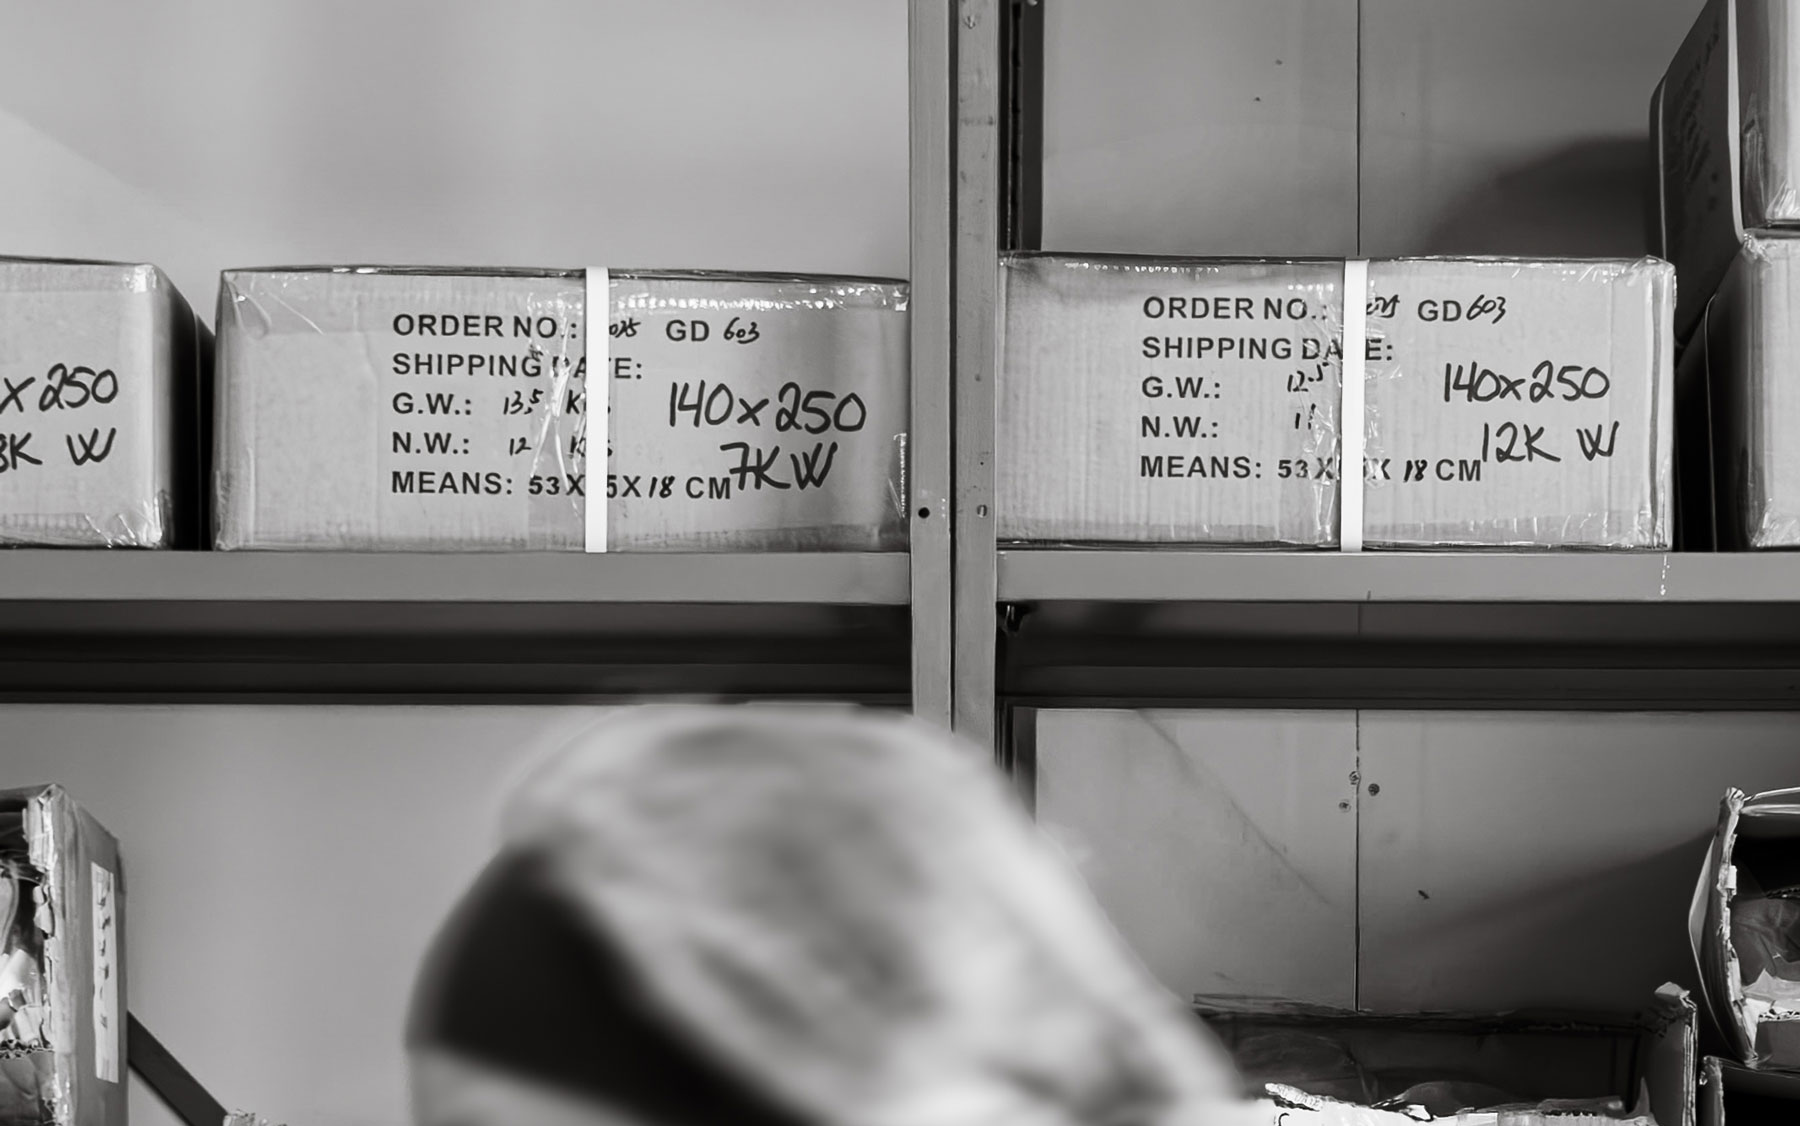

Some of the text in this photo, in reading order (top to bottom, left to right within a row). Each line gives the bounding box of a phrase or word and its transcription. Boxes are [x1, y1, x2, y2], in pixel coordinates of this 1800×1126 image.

[1143, 295, 1254, 320] ORDER
[1417, 299, 1462, 323] GD
[1466, 293, 1506, 325] 603
[392, 313, 503, 337] ORDER
[665, 318, 710, 342] GD
[723, 316, 761, 345] 603
[1142, 335, 1393, 361] SHIPPING DAE:
[392, 352, 642, 380] SHIPPING DAE:
[1141, 375, 1221, 399] G.W.:
[392, 391, 472, 416] G.W.:
[669, 379, 867, 434] 140x250
[1141, 415, 1219, 439] N.W.:
[66, 427, 117, 466] W
[392, 431, 532, 456] N.W.: 12
[1140, 455, 1262, 479] MEANS:
[1435, 459, 1481, 482] CM
[391, 470, 513, 495] MEANS:
[685, 476, 731, 500] CM
